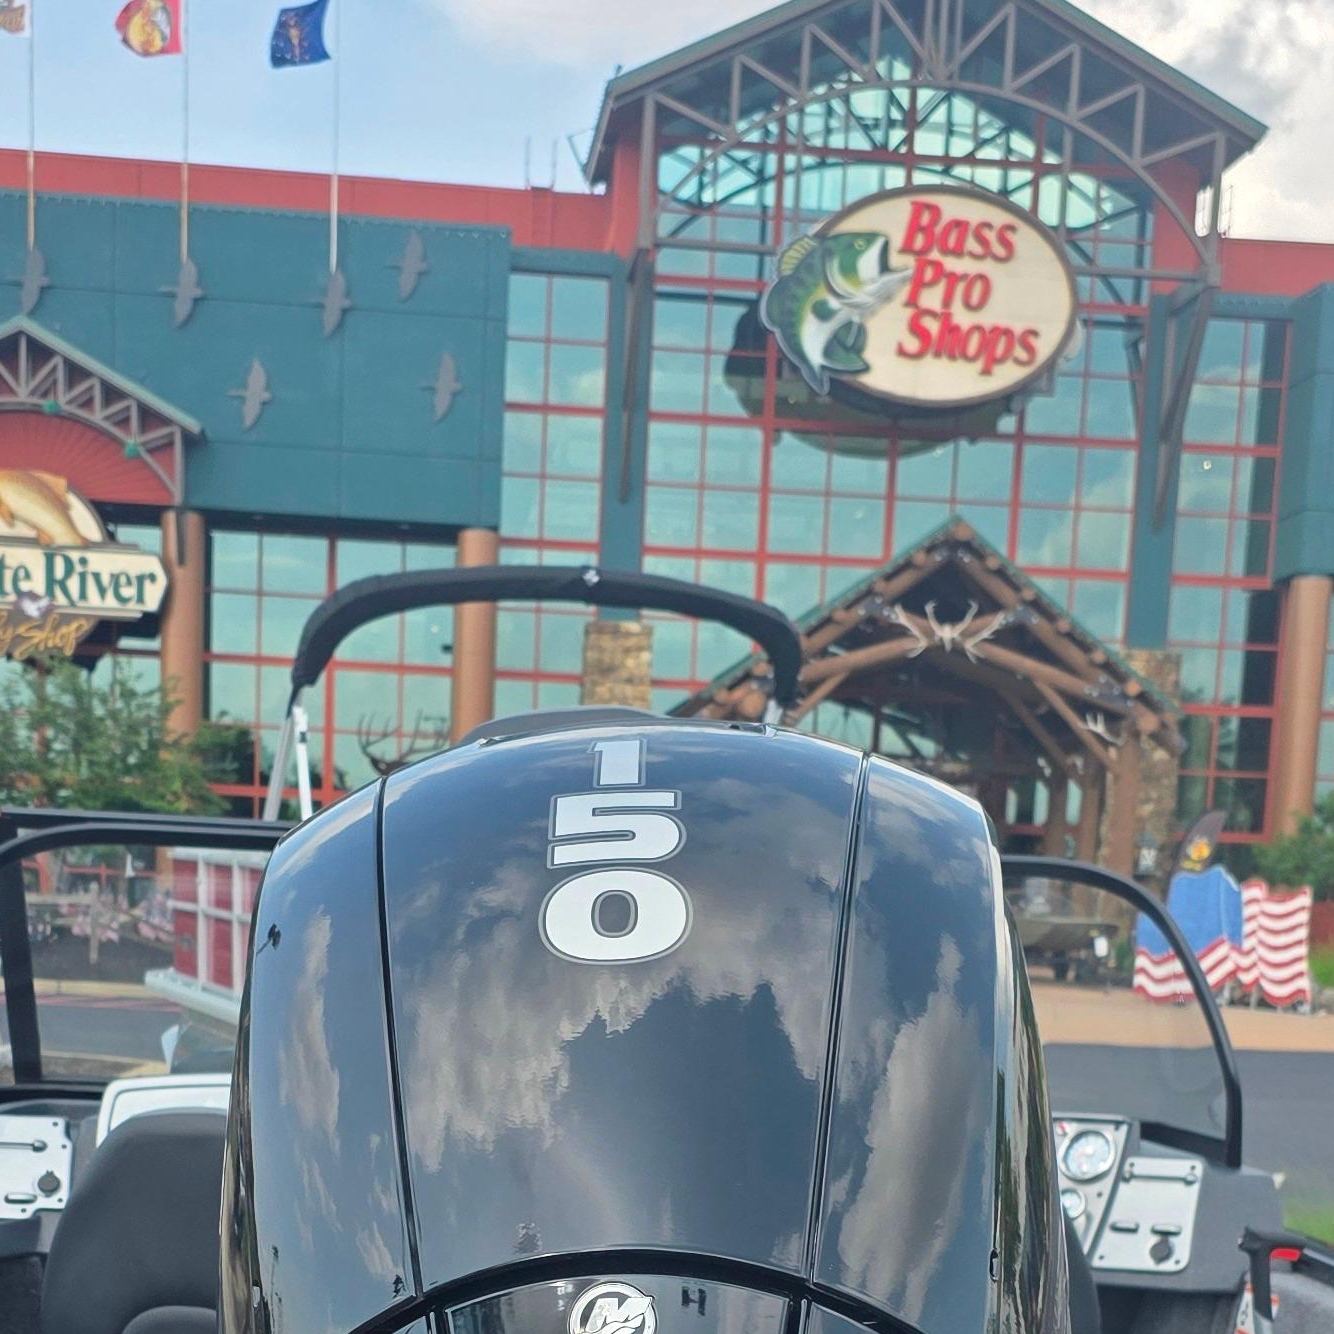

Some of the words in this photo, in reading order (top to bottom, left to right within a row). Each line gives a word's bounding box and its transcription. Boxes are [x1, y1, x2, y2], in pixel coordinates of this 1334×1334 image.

[899, 199, 1016, 263] Bass
[903, 256, 992, 311] Pro
[895, 307, 1041, 376] Shops
[42, 550, 158, 607] River
[15, 612, 89, 660] Shop
[537, 738, 694, 966] 150
